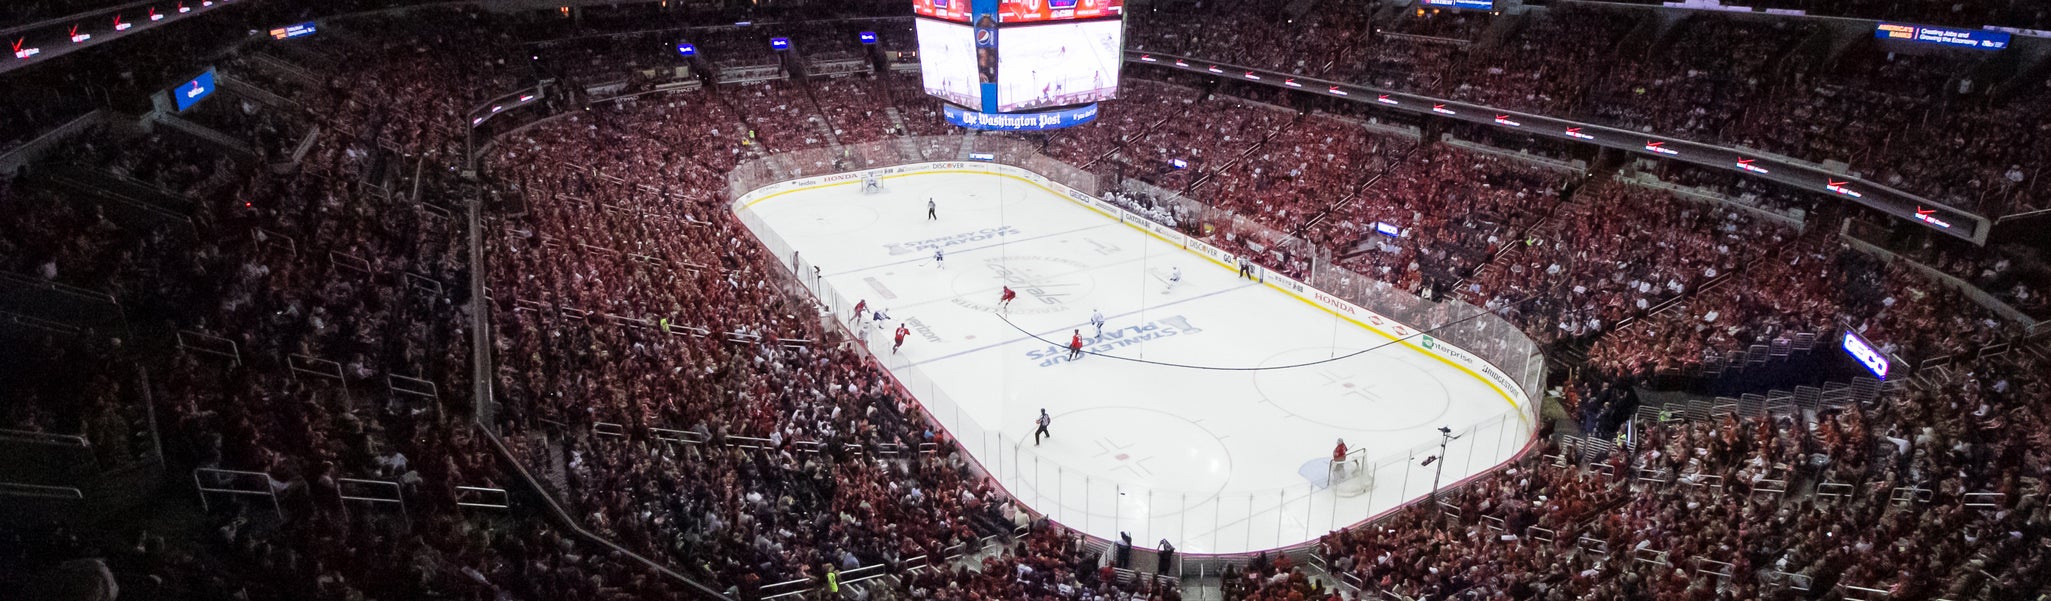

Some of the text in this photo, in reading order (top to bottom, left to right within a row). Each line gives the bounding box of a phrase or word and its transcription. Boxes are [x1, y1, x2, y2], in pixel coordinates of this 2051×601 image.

[1921, 28, 1944, 37] Creating
[1951, 37, 1978, 46] Economy
[962, 111, 977, 125] The
[978, 112, 1037, 130] Washington
[1038, 113, 1061, 129] Post
[823, 173, 858, 183] HONDA
[1125, 211, 1151, 229] GATORADE
[904, 231, 975, 247] STANLEY
[1189, 240, 1218, 257] DISCOVER
[1314, 292, 1356, 315] HONDA
[906, 316, 943, 343] verizon
[1091, 327, 1178, 353] STANLEY
[1843, 333, 1889, 377] GEICO
[1481, 364, 1520, 398] BRIDGESTONE
